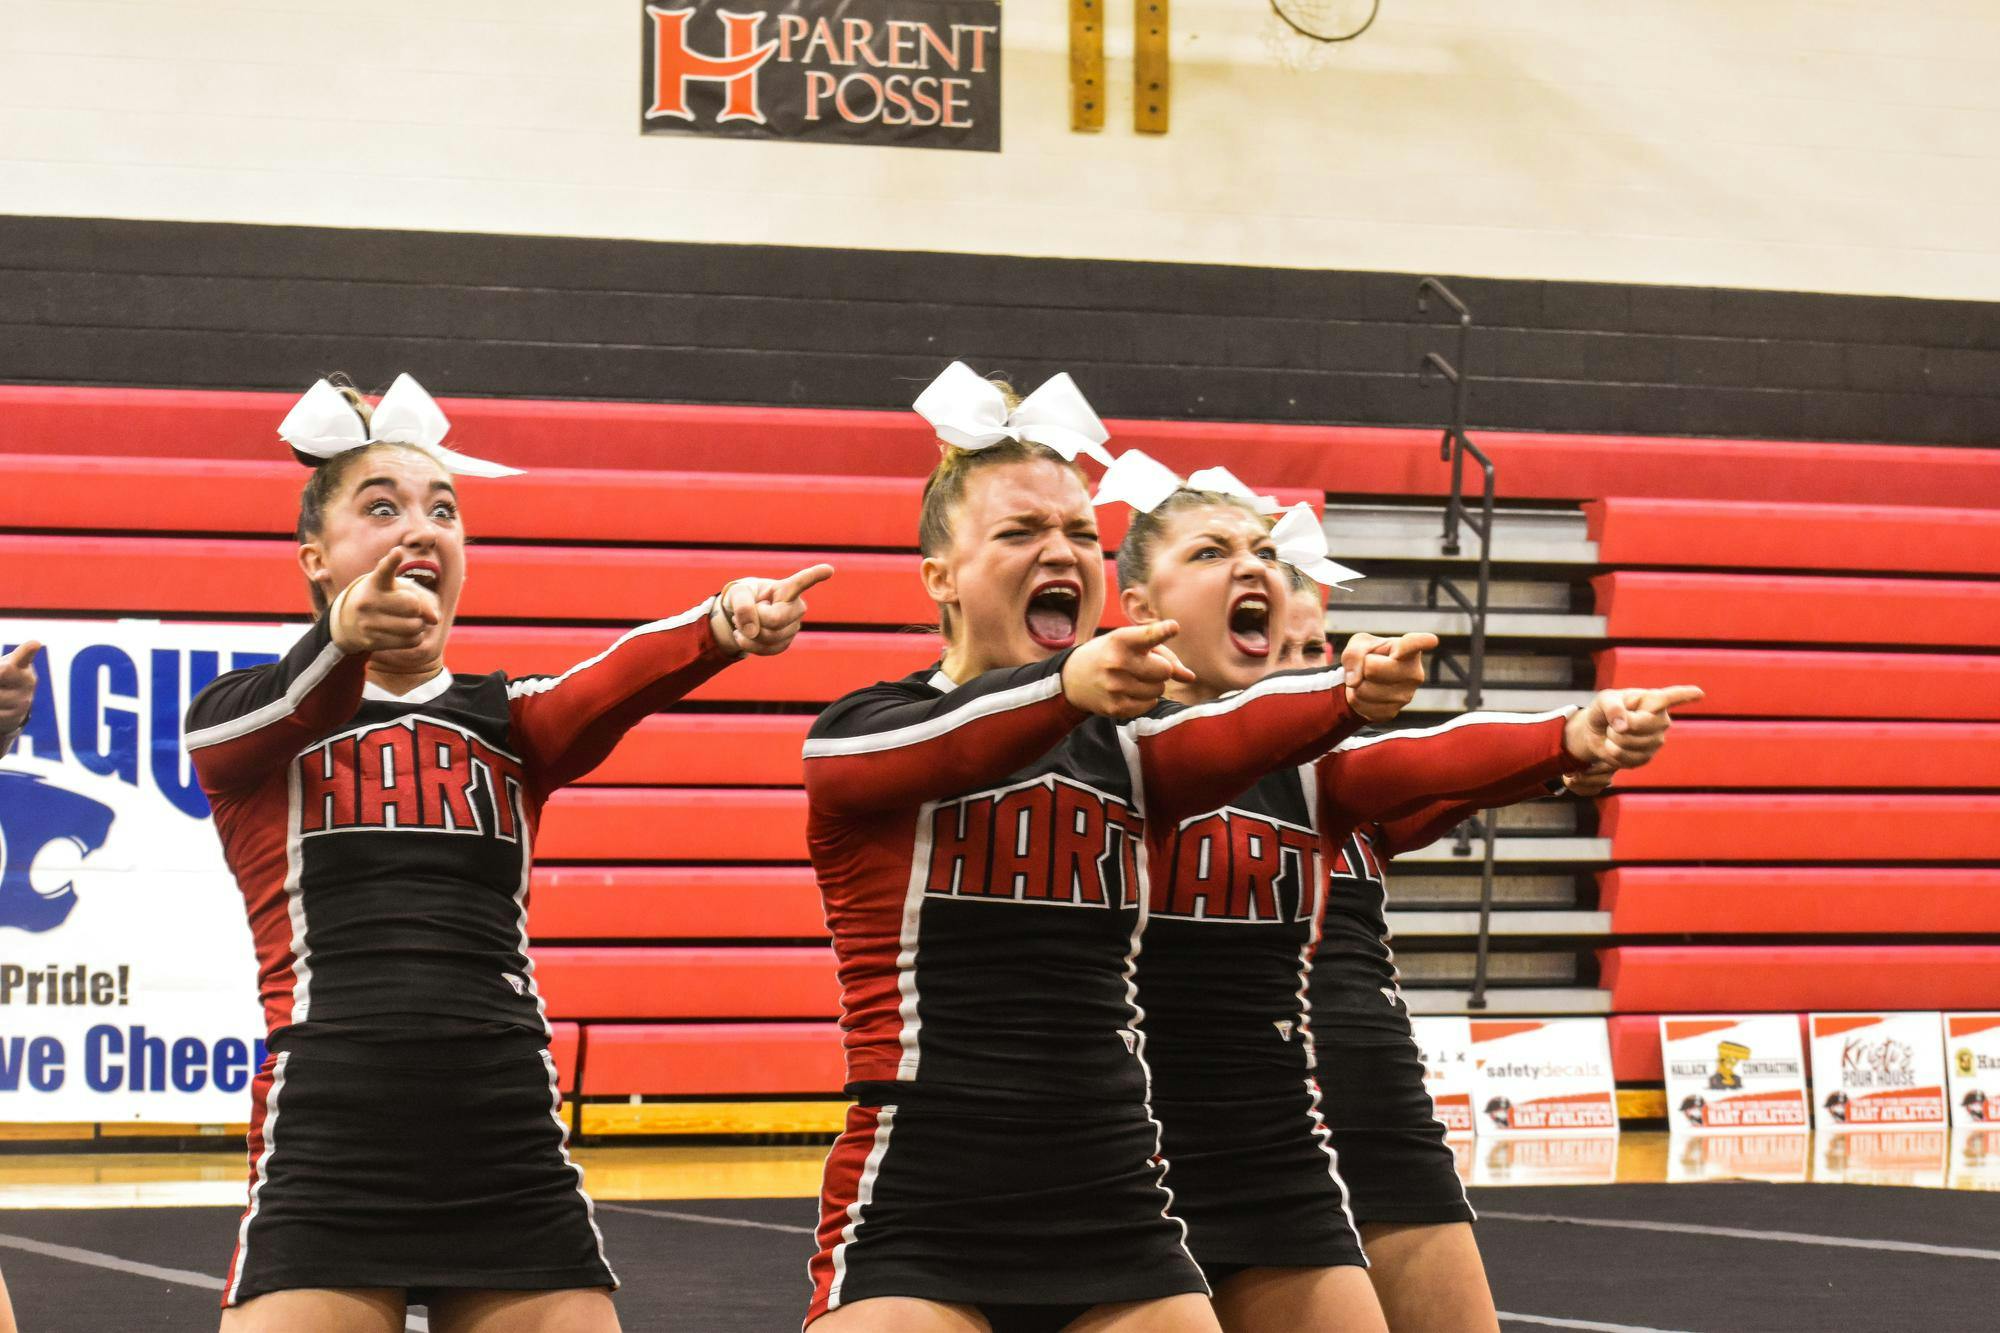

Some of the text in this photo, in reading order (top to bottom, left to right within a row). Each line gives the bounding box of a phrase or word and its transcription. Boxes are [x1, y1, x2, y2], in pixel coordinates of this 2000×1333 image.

[645, 5, 779, 124] H
[776, 14, 998, 73] PARENT
[804, 70, 974, 128] POSSE
[301, 714, 522, 843] HART
[926, 773, 1144, 909] HART
[0, 965, 130, 1006] Pride!
[1742, 1062, 1798, 1075] CONTRACTING
